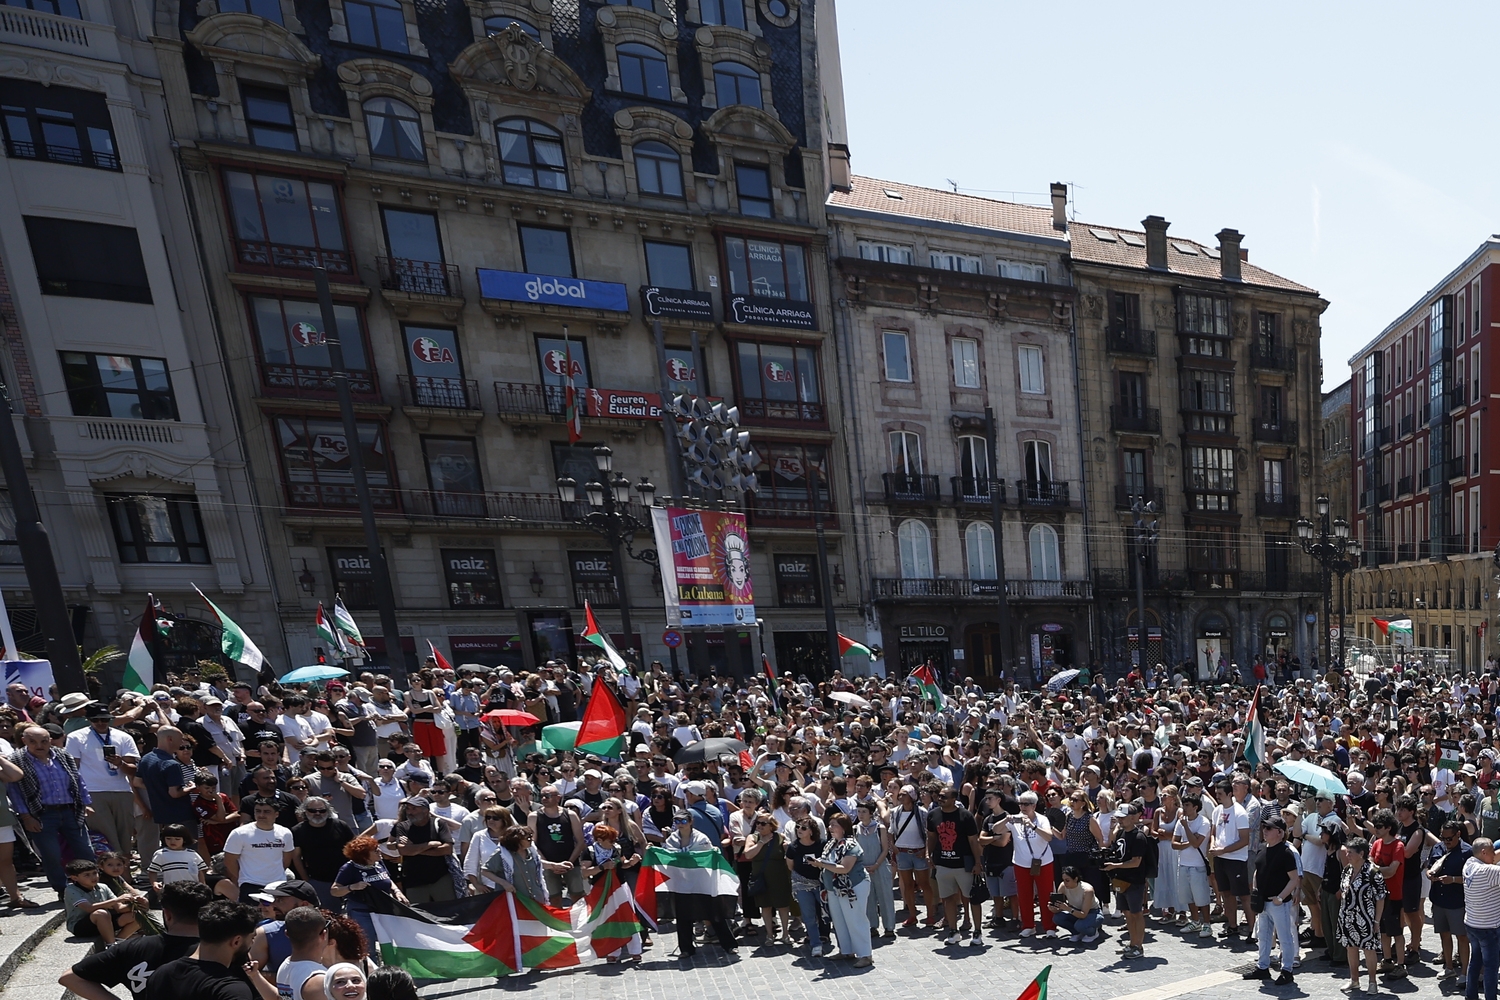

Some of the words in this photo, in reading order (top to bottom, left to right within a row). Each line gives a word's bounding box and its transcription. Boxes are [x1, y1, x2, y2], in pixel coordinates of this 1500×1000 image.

[748, 244, 781, 254] CLÍNICA
[748, 252, 783, 262] ARRIAGA
[525, 276, 586, 300] global
[657, 296, 682, 304] CLÍNICA
[682, 299, 710, 307] ARRIAGA
[742, 304, 775, 315] CLÍNICA
[776, 308, 812, 318] ARRIAGA
[429, 347, 454, 362] EA
[776, 370, 794, 382] EA
[610, 394, 648, 406] Geurea,
[609, 404, 646, 416] Euskal
[319, 436, 348, 452] BG
[780, 460, 800, 473] BG
[679, 586, 690, 600] La
[691, 586, 724, 600] Cubana
[902, 626, 916, 637] EL
[920, 626, 946, 636] TILO
